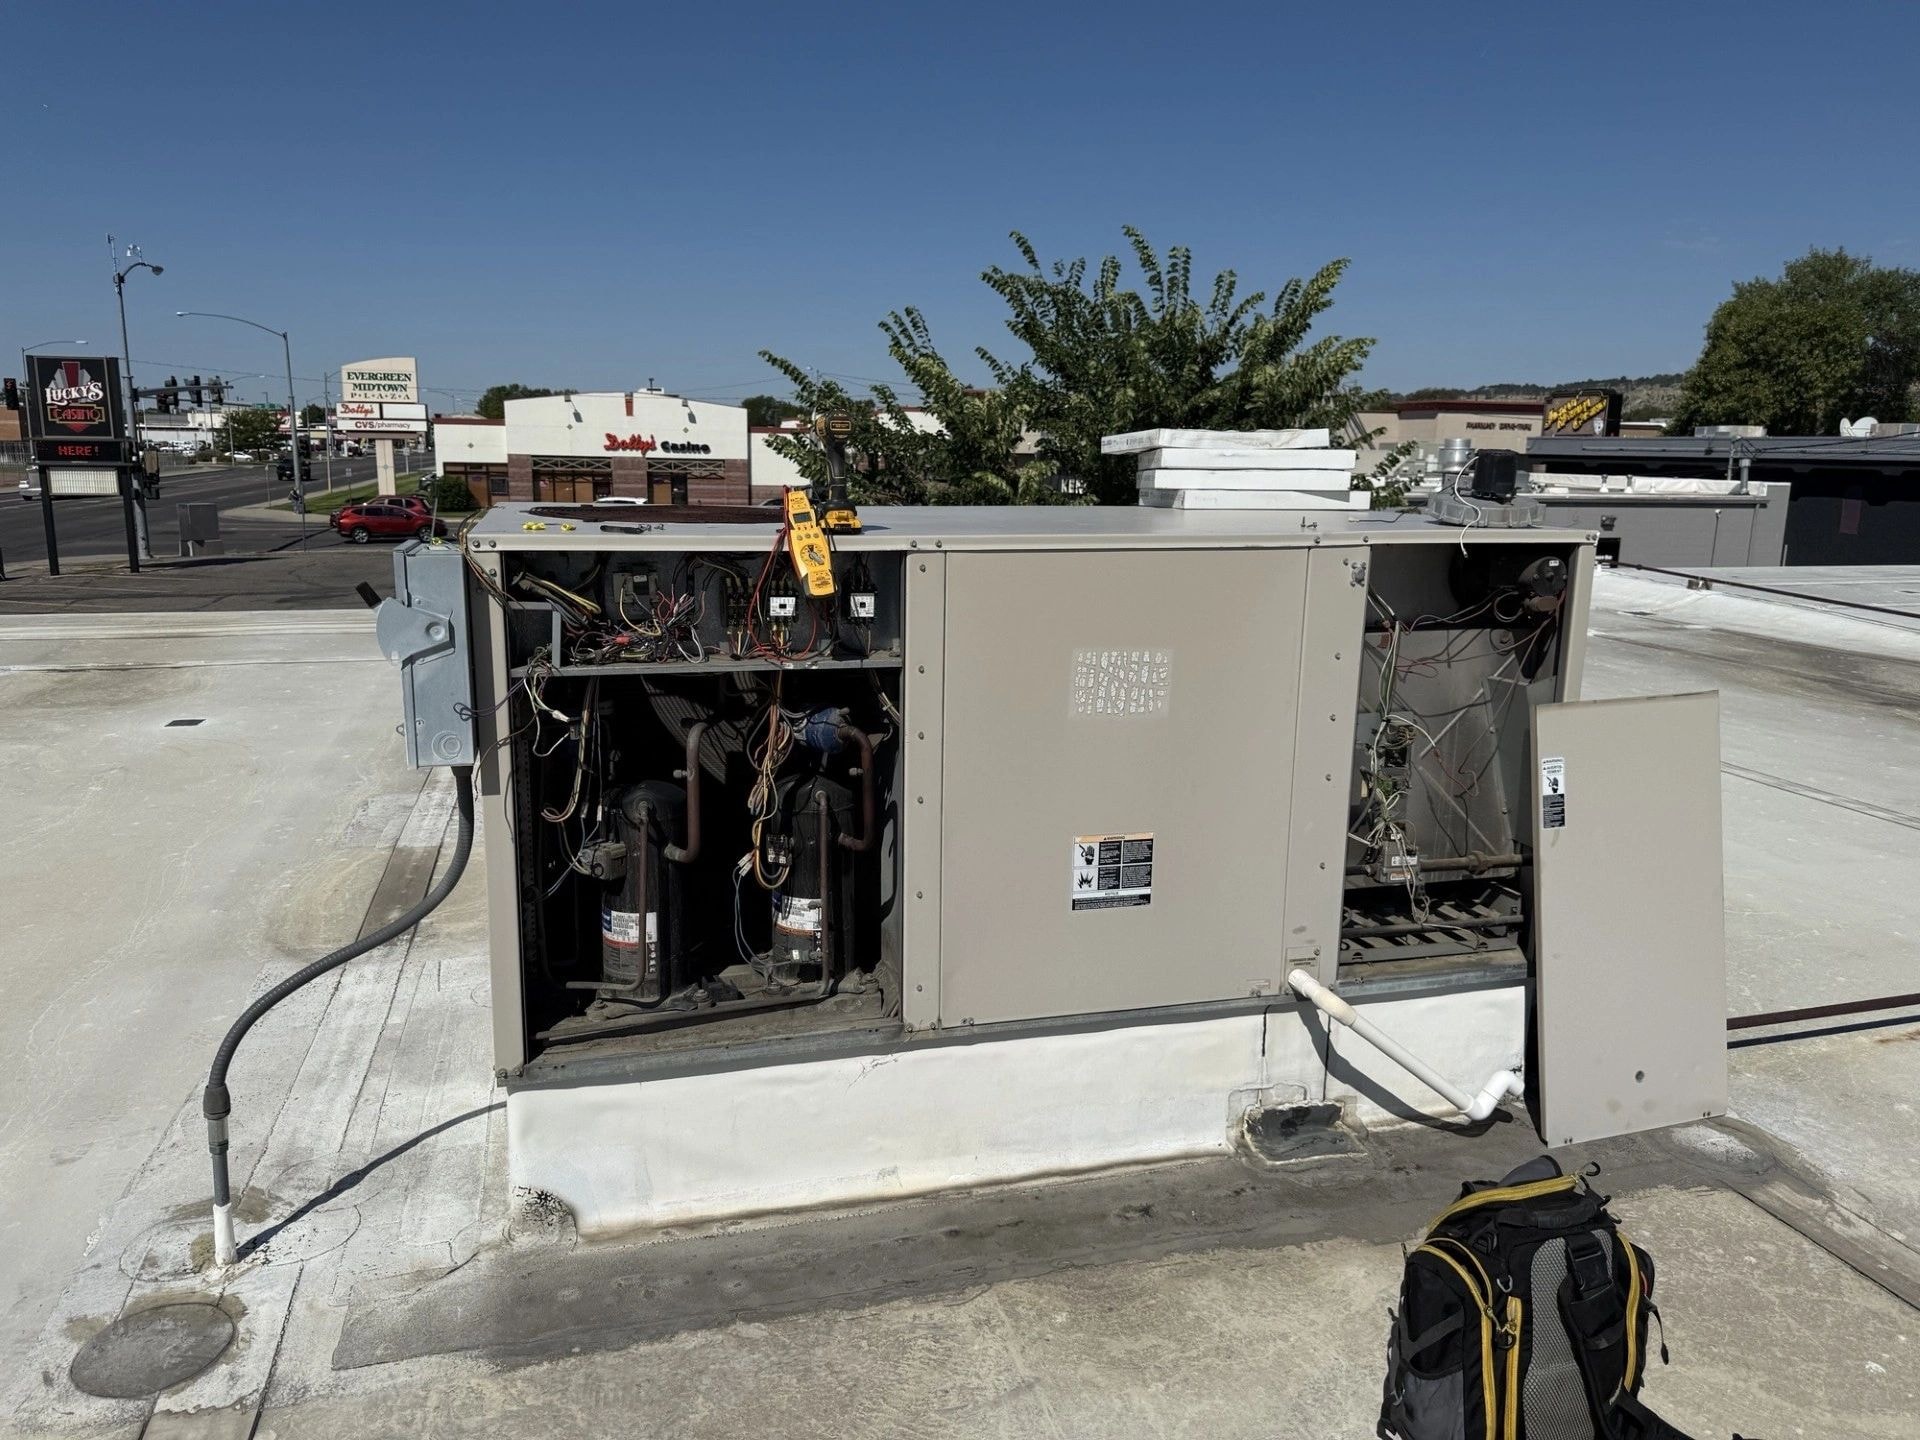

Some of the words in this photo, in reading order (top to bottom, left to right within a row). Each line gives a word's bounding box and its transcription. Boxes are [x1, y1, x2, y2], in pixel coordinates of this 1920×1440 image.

[347, 371, 412, 381] EVERGREEN
[353, 384, 407, 392] MIDTOWN
[45, 382, 104, 406] LUCKY'S
[53, 409, 101, 420] CASINO
[340, 404, 375, 416] Dotty's
[661, 441, 711, 454] Casino
